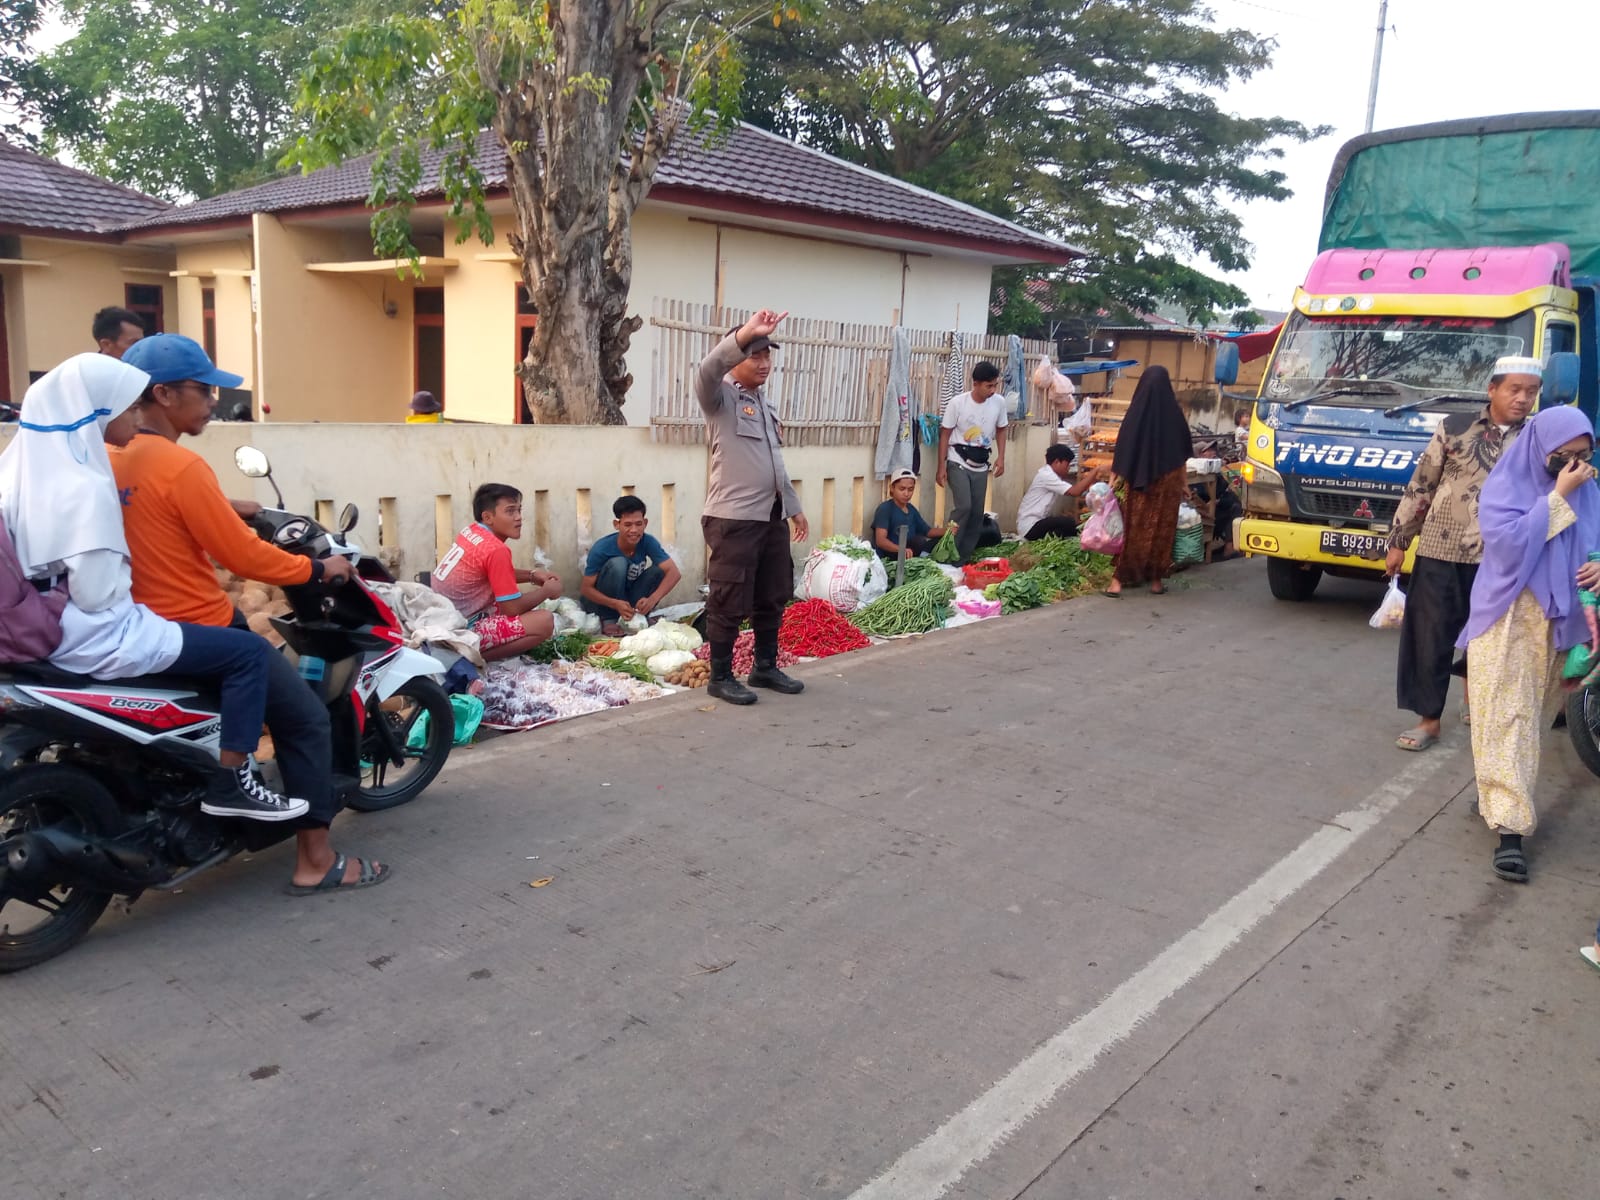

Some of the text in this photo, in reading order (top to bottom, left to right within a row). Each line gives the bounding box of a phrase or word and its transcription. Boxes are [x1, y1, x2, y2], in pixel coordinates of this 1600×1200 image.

[1275, 441, 1355, 466] TWO
[1301, 477, 1386, 490] MITSUBISHI
[1322, 532, 1337, 547] BE
[1342, 534, 1373, 549] 8929
